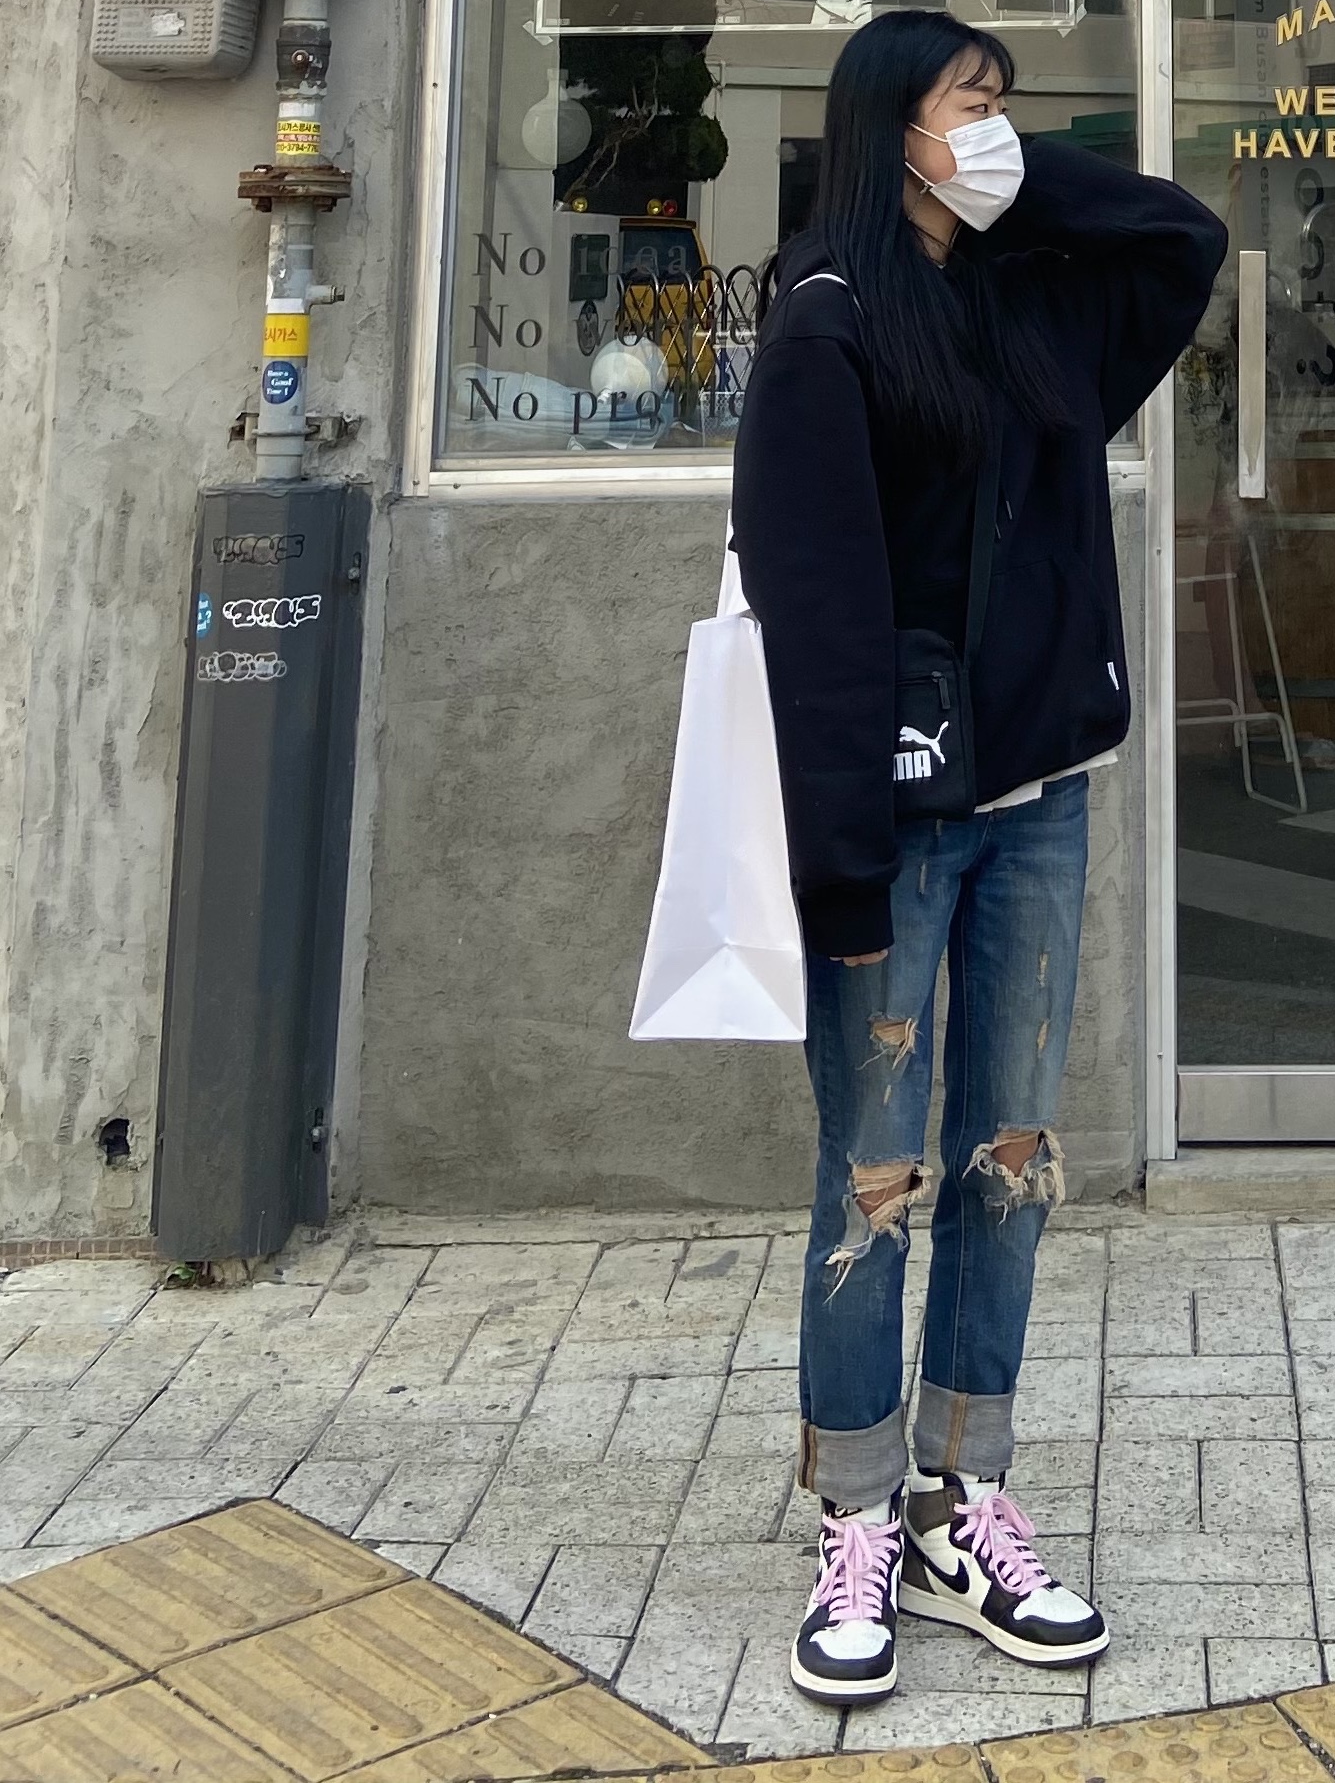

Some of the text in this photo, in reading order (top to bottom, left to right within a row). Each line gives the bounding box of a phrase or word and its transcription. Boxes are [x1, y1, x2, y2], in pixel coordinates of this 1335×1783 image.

[472, 231, 546, 277] No
[467, 303, 543, 349] No
[464, 376, 539, 422] No
[893, 749, 932, 781] MA
